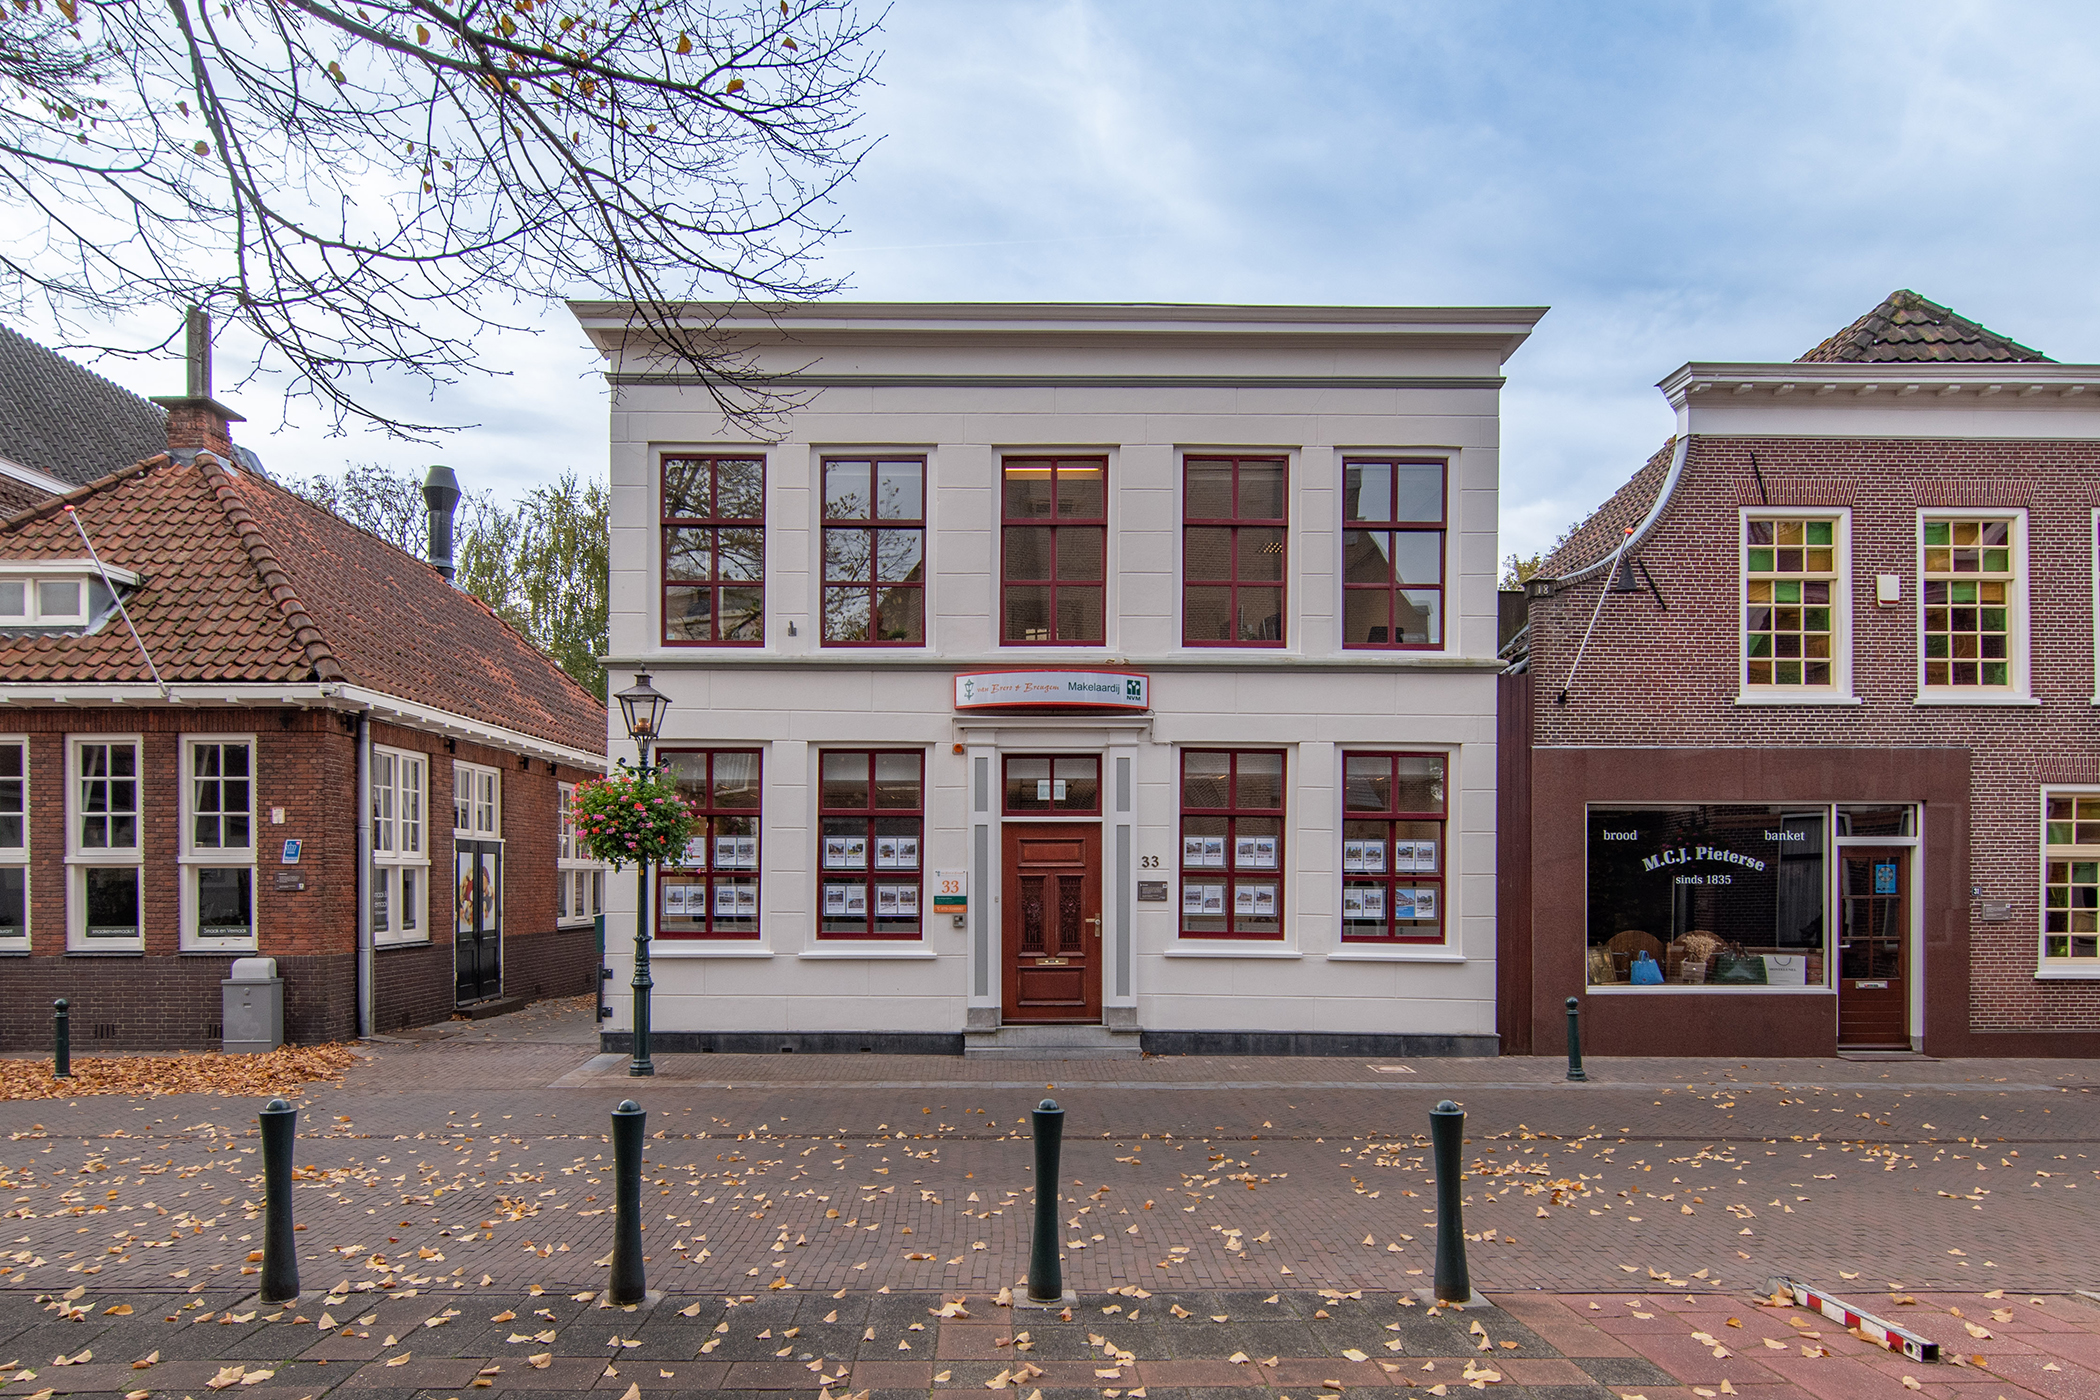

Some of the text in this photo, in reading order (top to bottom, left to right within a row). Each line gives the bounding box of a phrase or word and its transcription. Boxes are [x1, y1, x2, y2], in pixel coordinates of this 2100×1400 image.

[1537, 584, 1549, 595] 18
[1068, 681, 1121, 695] Makelaardij
[1603, 829, 1638, 841] brood
[1764, 829, 1805, 841] banket
[1141, 855, 1159, 868] 33
[1641, 846, 1766, 872] M.C.J. Pieterse
[1675, 874, 1732, 885] sinds 1835
[941, 880, 959, 894] 33
